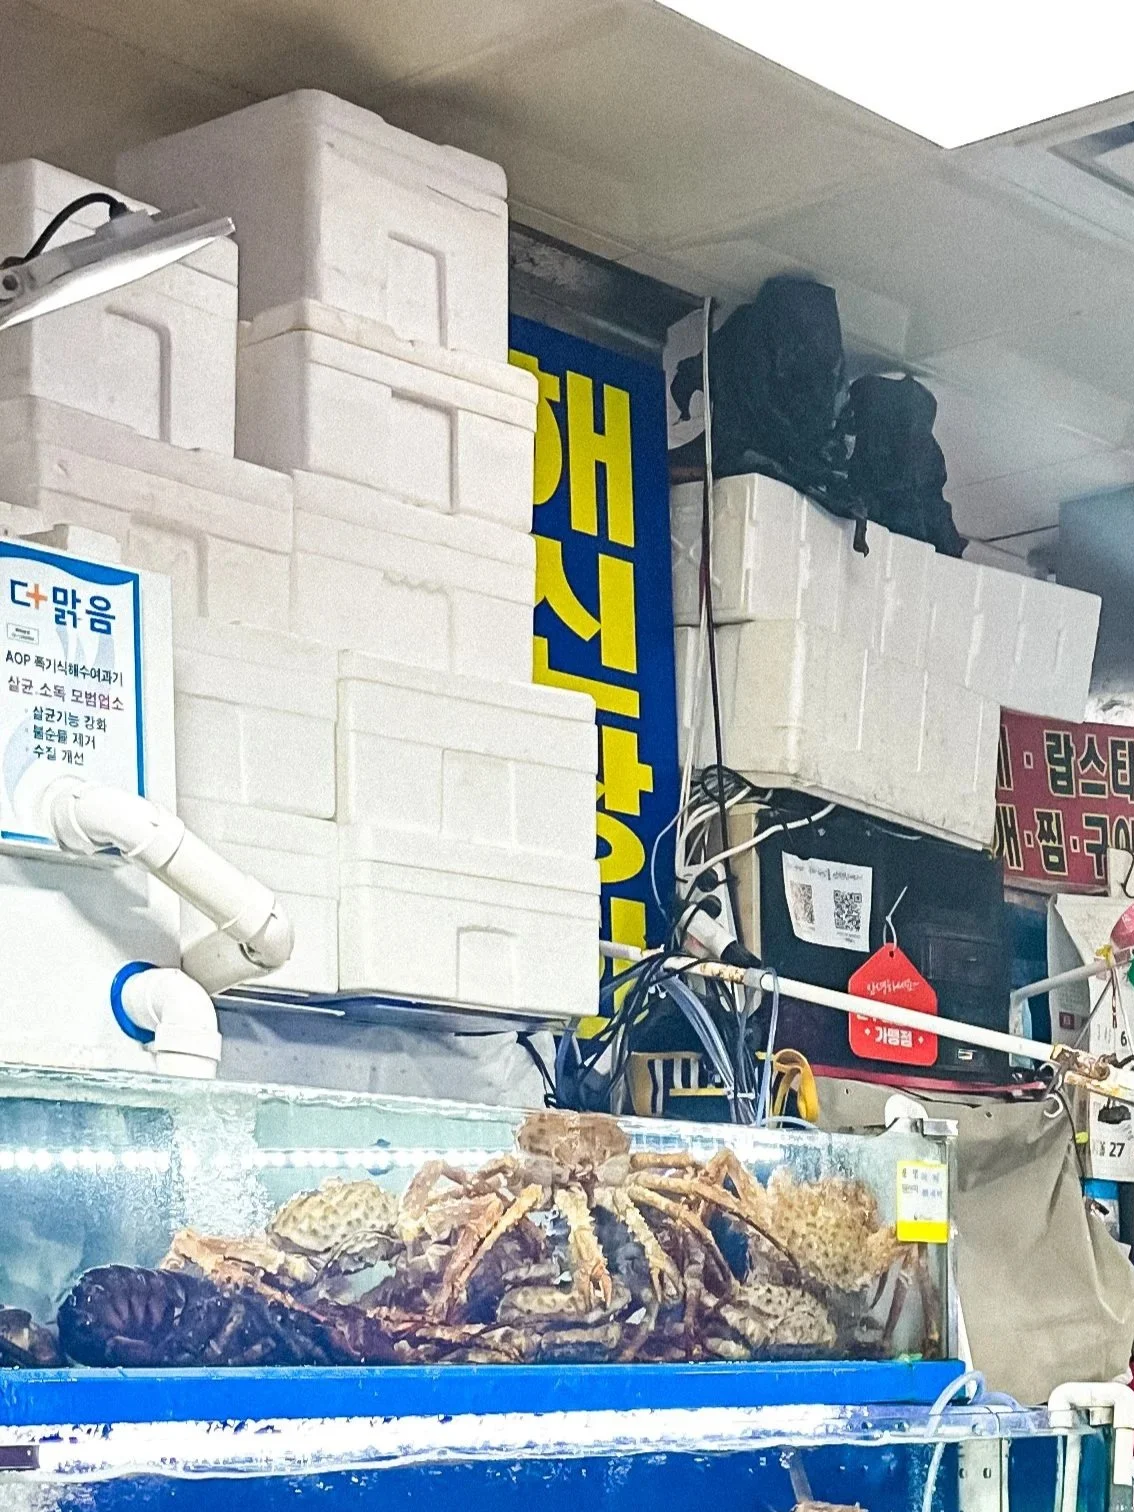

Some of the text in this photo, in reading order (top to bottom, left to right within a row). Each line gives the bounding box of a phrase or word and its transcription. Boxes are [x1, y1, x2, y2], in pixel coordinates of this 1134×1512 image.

[6, 650, 31, 667] AOP
[70, 690, 126, 712] 모범업소
[32, 706, 108, 734] 살균기능 강화
[72, 732, 97, 751] 제거
[32, 744, 85, 766] 수질 개선
[1120, 1031, 1128, 1047] 6
[1109, 1142, 1125, 1158] 27
